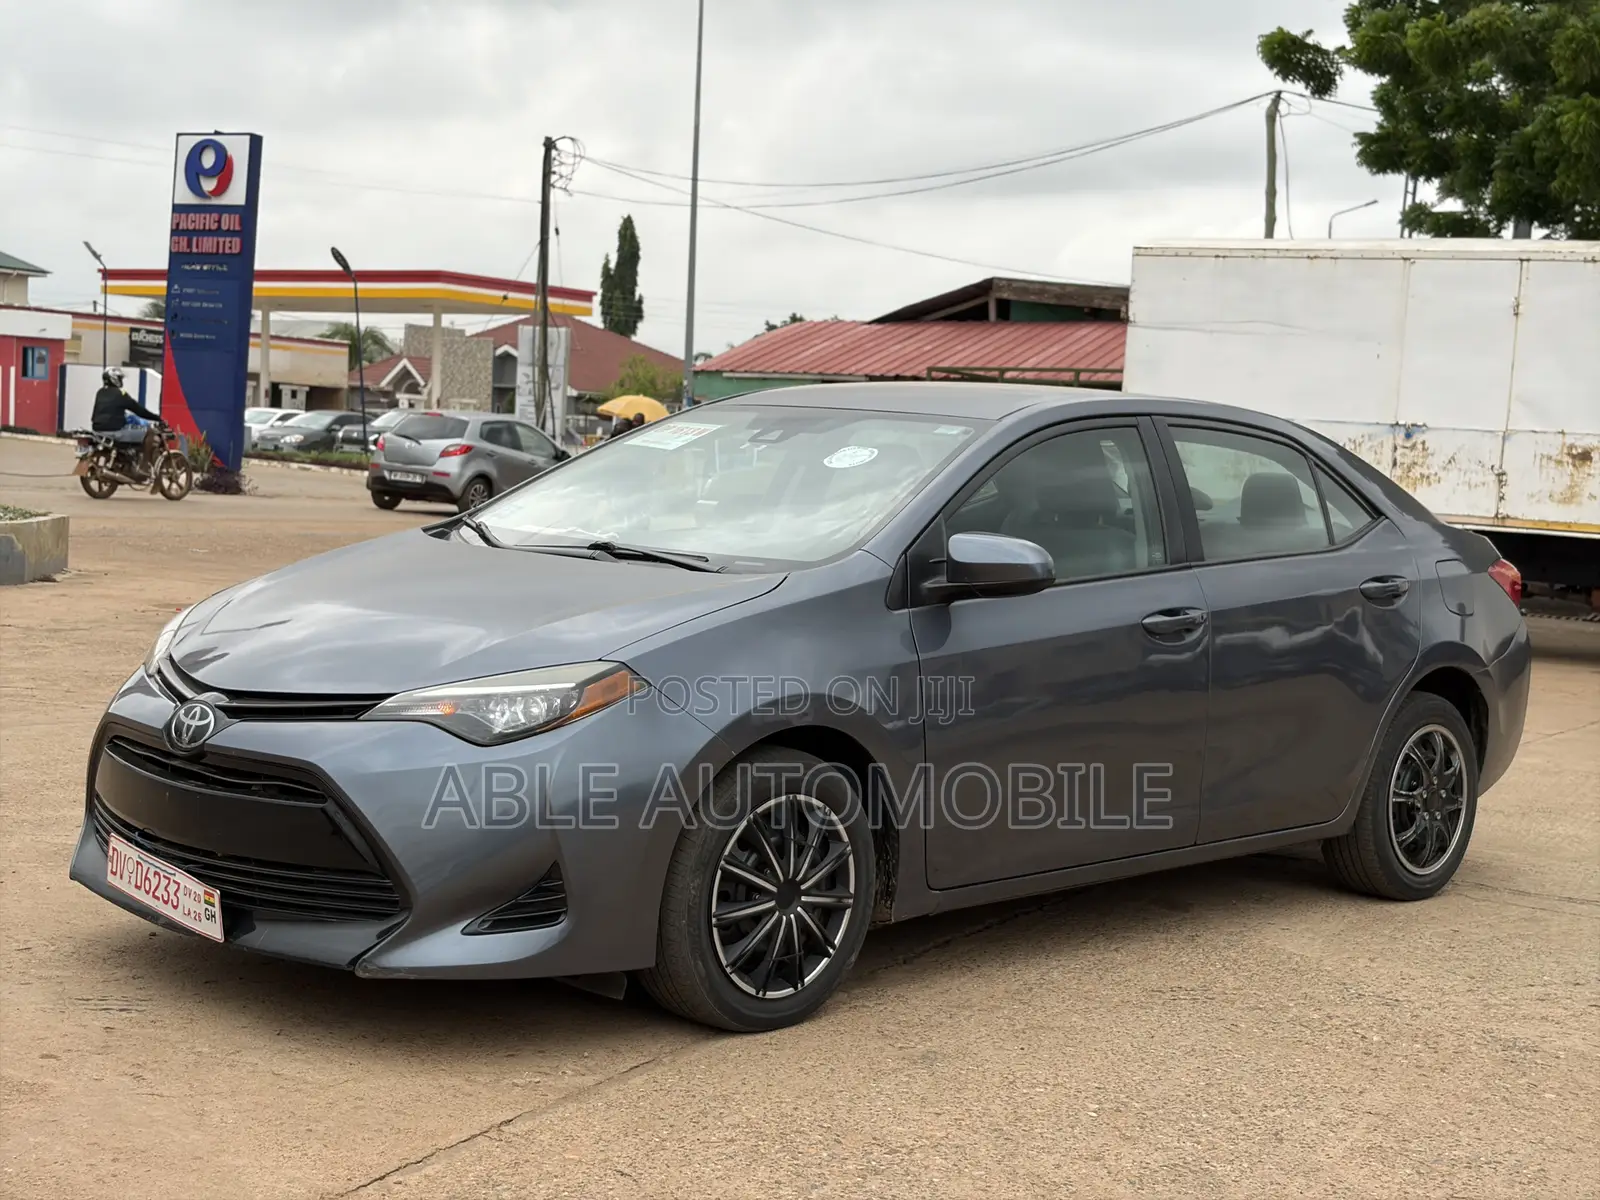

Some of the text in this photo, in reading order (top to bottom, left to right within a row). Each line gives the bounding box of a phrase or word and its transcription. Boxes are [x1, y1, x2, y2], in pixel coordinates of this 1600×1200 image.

[172, 212, 241, 231] PACIFIC OIL
[171, 236, 241, 254] GH. LIMITED
[204, 907, 217, 924] GH
